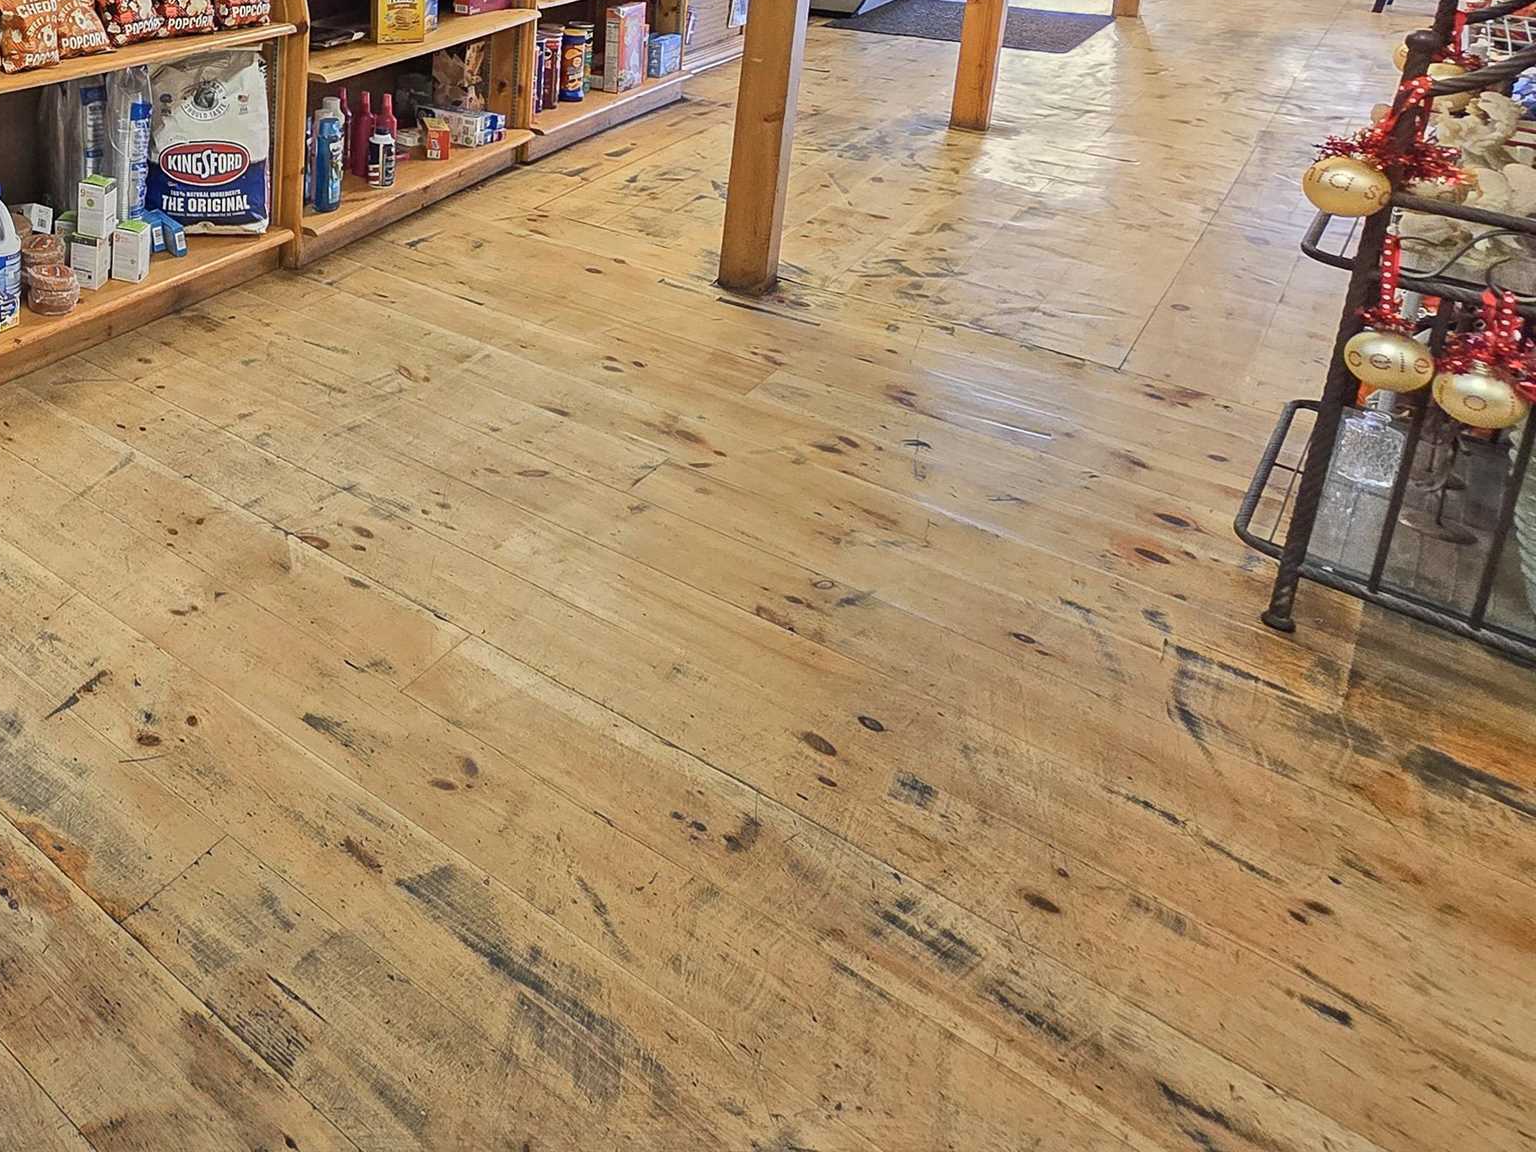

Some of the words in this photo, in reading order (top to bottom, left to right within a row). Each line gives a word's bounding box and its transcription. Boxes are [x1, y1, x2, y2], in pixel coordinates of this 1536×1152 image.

[168, 149, 243, 179] KINGSFORD
[162, 194, 185, 212] THE
[187, 194, 251, 213] ORIGINAL
